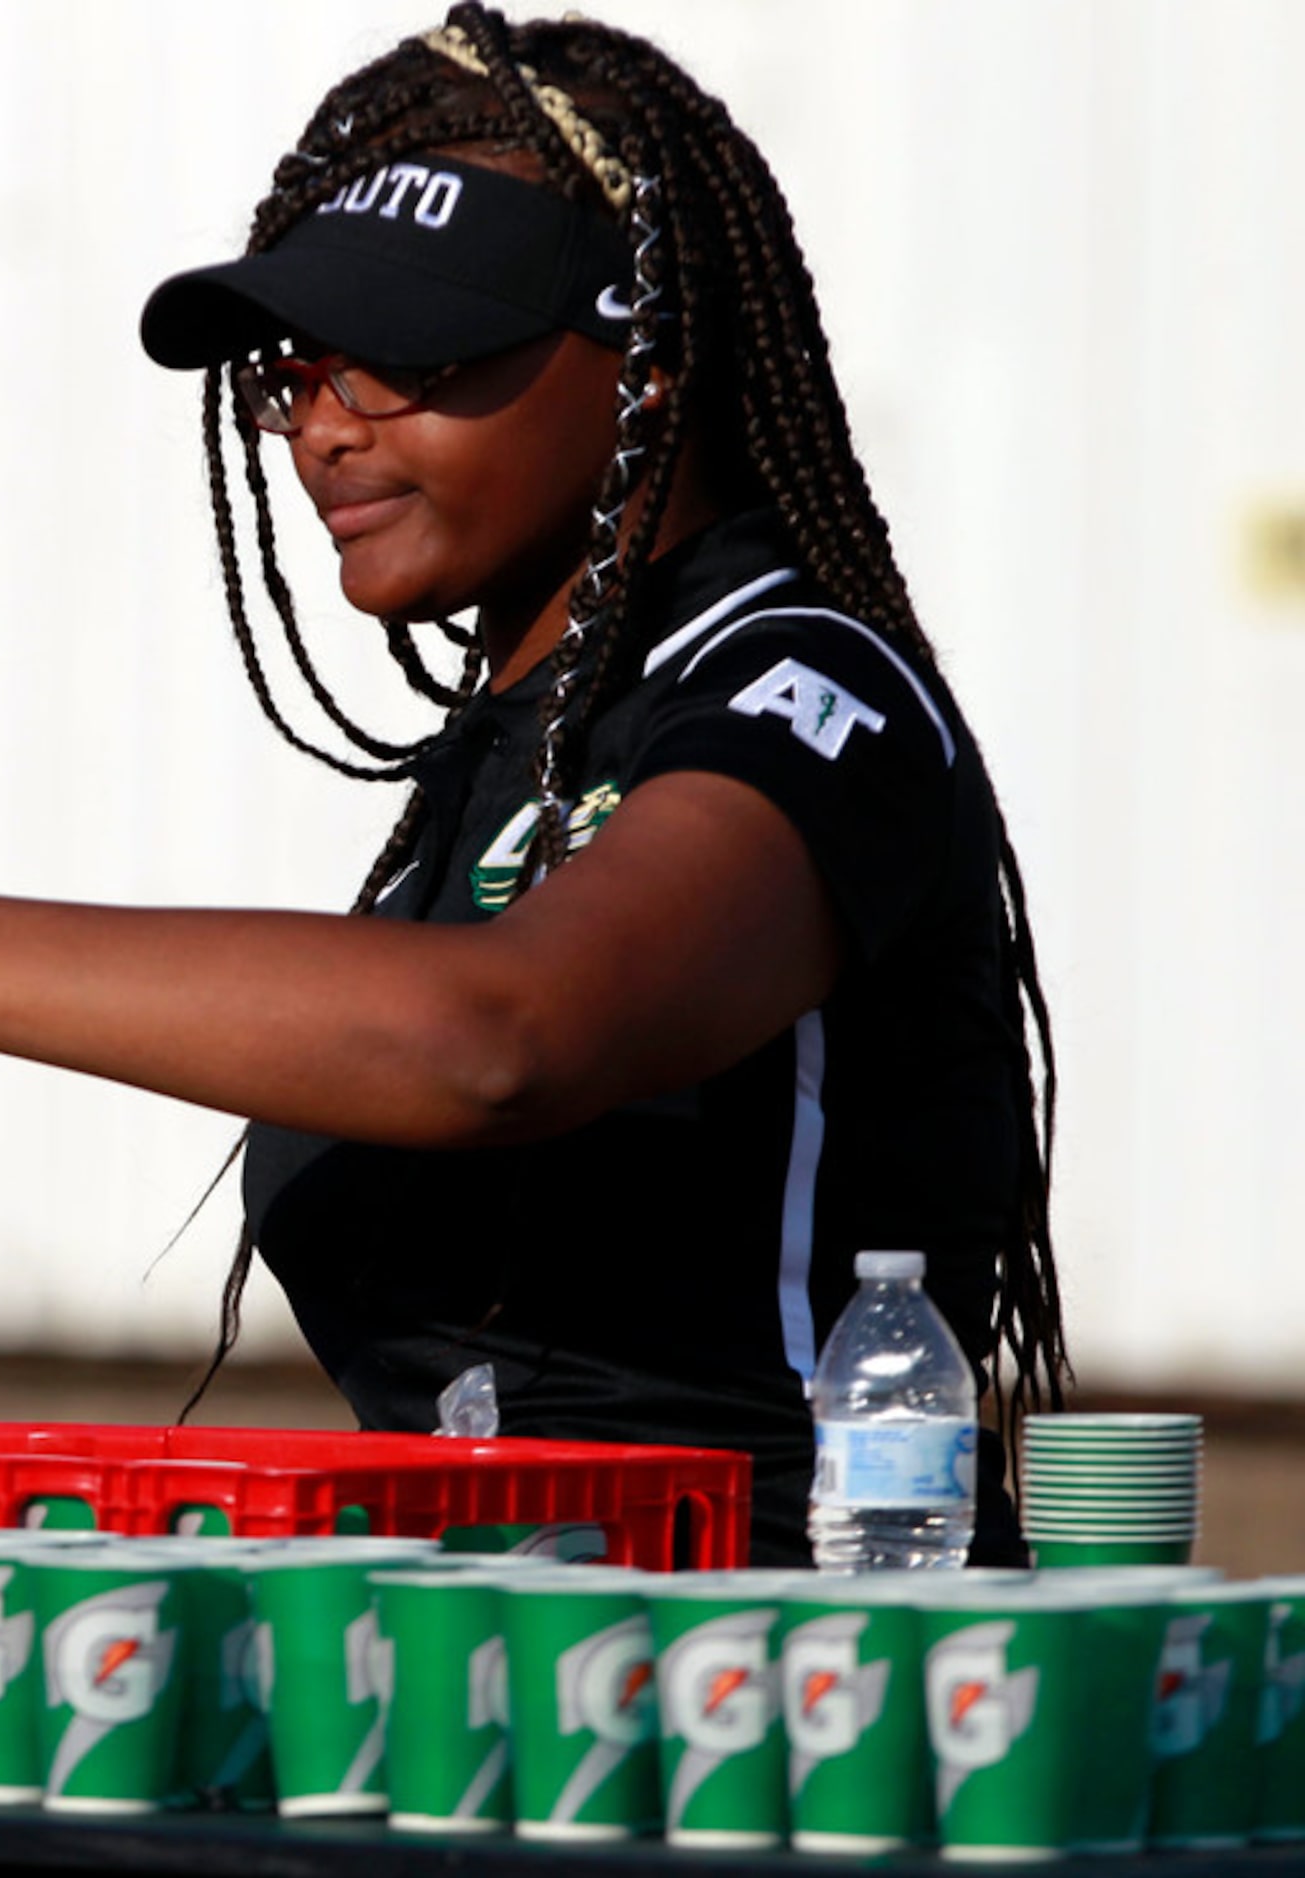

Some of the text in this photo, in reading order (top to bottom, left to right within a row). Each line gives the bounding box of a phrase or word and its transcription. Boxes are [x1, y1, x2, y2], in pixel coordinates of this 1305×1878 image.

[727, 656, 888, 762] AT
[57, 1607, 157, 1724] G
[668, 1633, 769, 1754] G
[783, 1637, 858, 1757] G
[925, 1648, 1011, 1768] G
